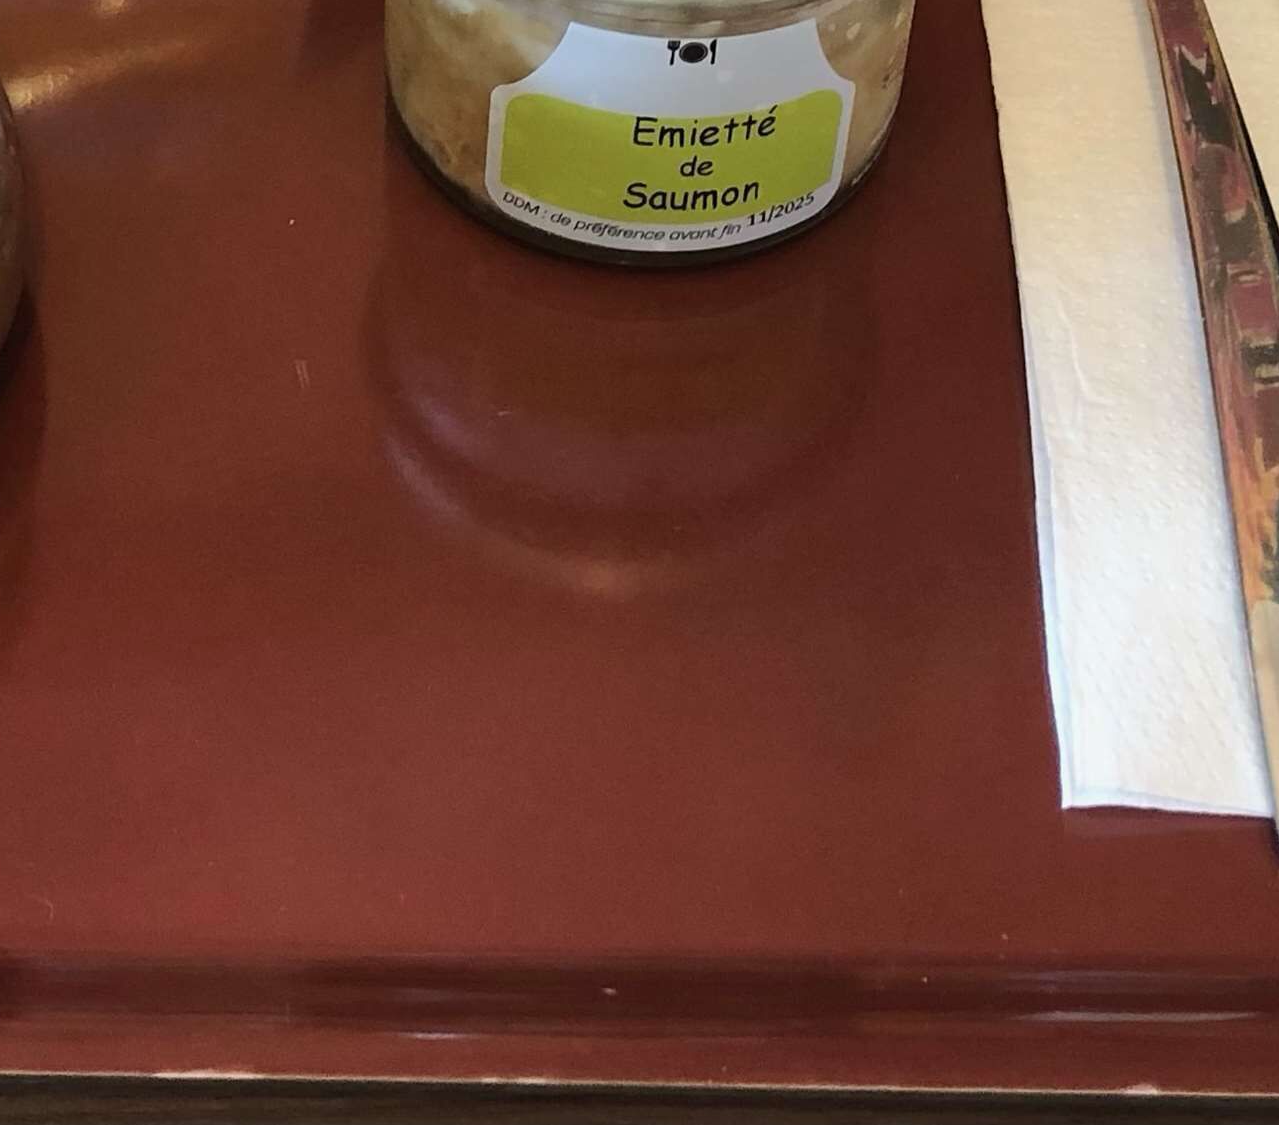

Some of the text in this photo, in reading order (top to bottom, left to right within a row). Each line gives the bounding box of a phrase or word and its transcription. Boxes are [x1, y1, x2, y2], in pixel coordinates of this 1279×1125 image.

[632, 104, 778, 148] Emietté
[680, 155, 714, 177] de
[623, 180, 759, 211] Saumon
[502, 191, 541, 217] DDM
[550, 211, 571, 226] de
[669, 227, 716, 241] avant
[719, 223, 742, 240] fin
[746, 191, 816, 226] 11/2025
